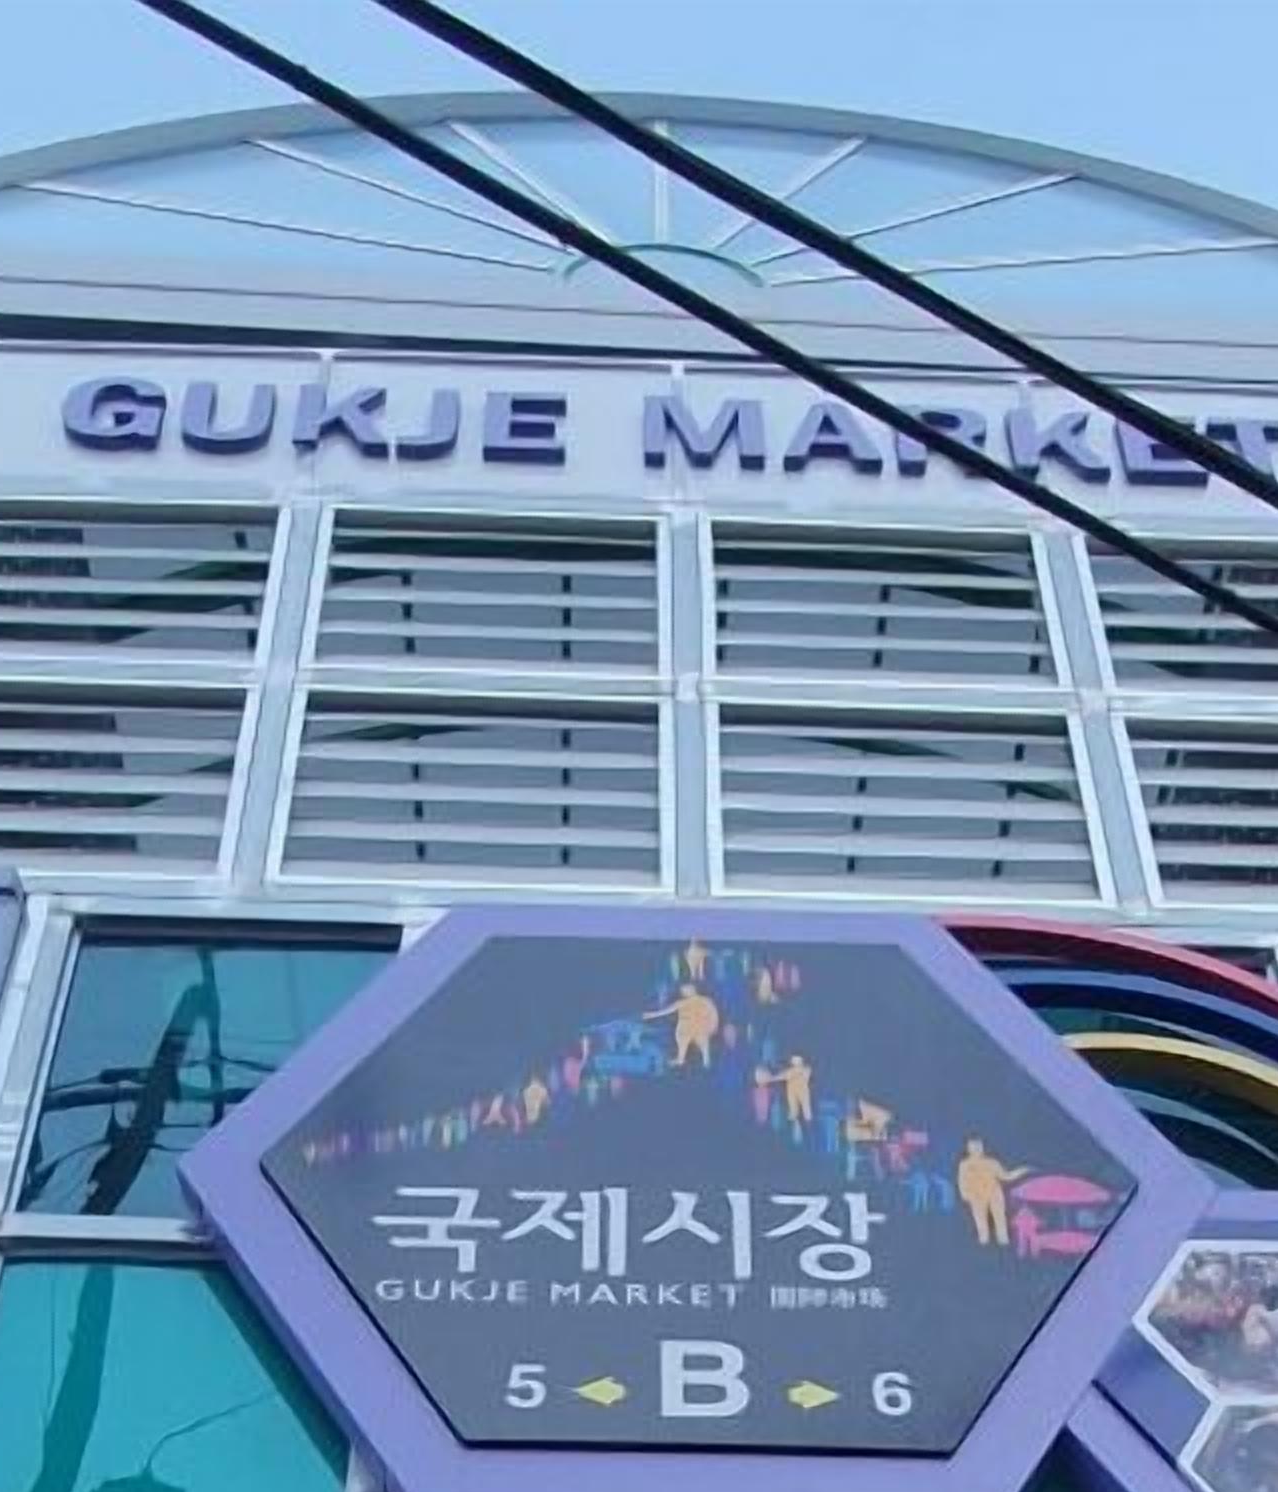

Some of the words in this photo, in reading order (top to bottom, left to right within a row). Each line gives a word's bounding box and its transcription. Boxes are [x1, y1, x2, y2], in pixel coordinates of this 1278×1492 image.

[61, 376, 567, 465] GUKJE
[373, 1185, 887, 1282] 국제시장
[374, 1279, 529, 1304] GUKJE
[550, 1280, 745, 1308] MARKET
[505, 1363, 548, 1409] 5
[659, 1339, 750, 1418] B
[872, 1371, 914, 1416] 6
